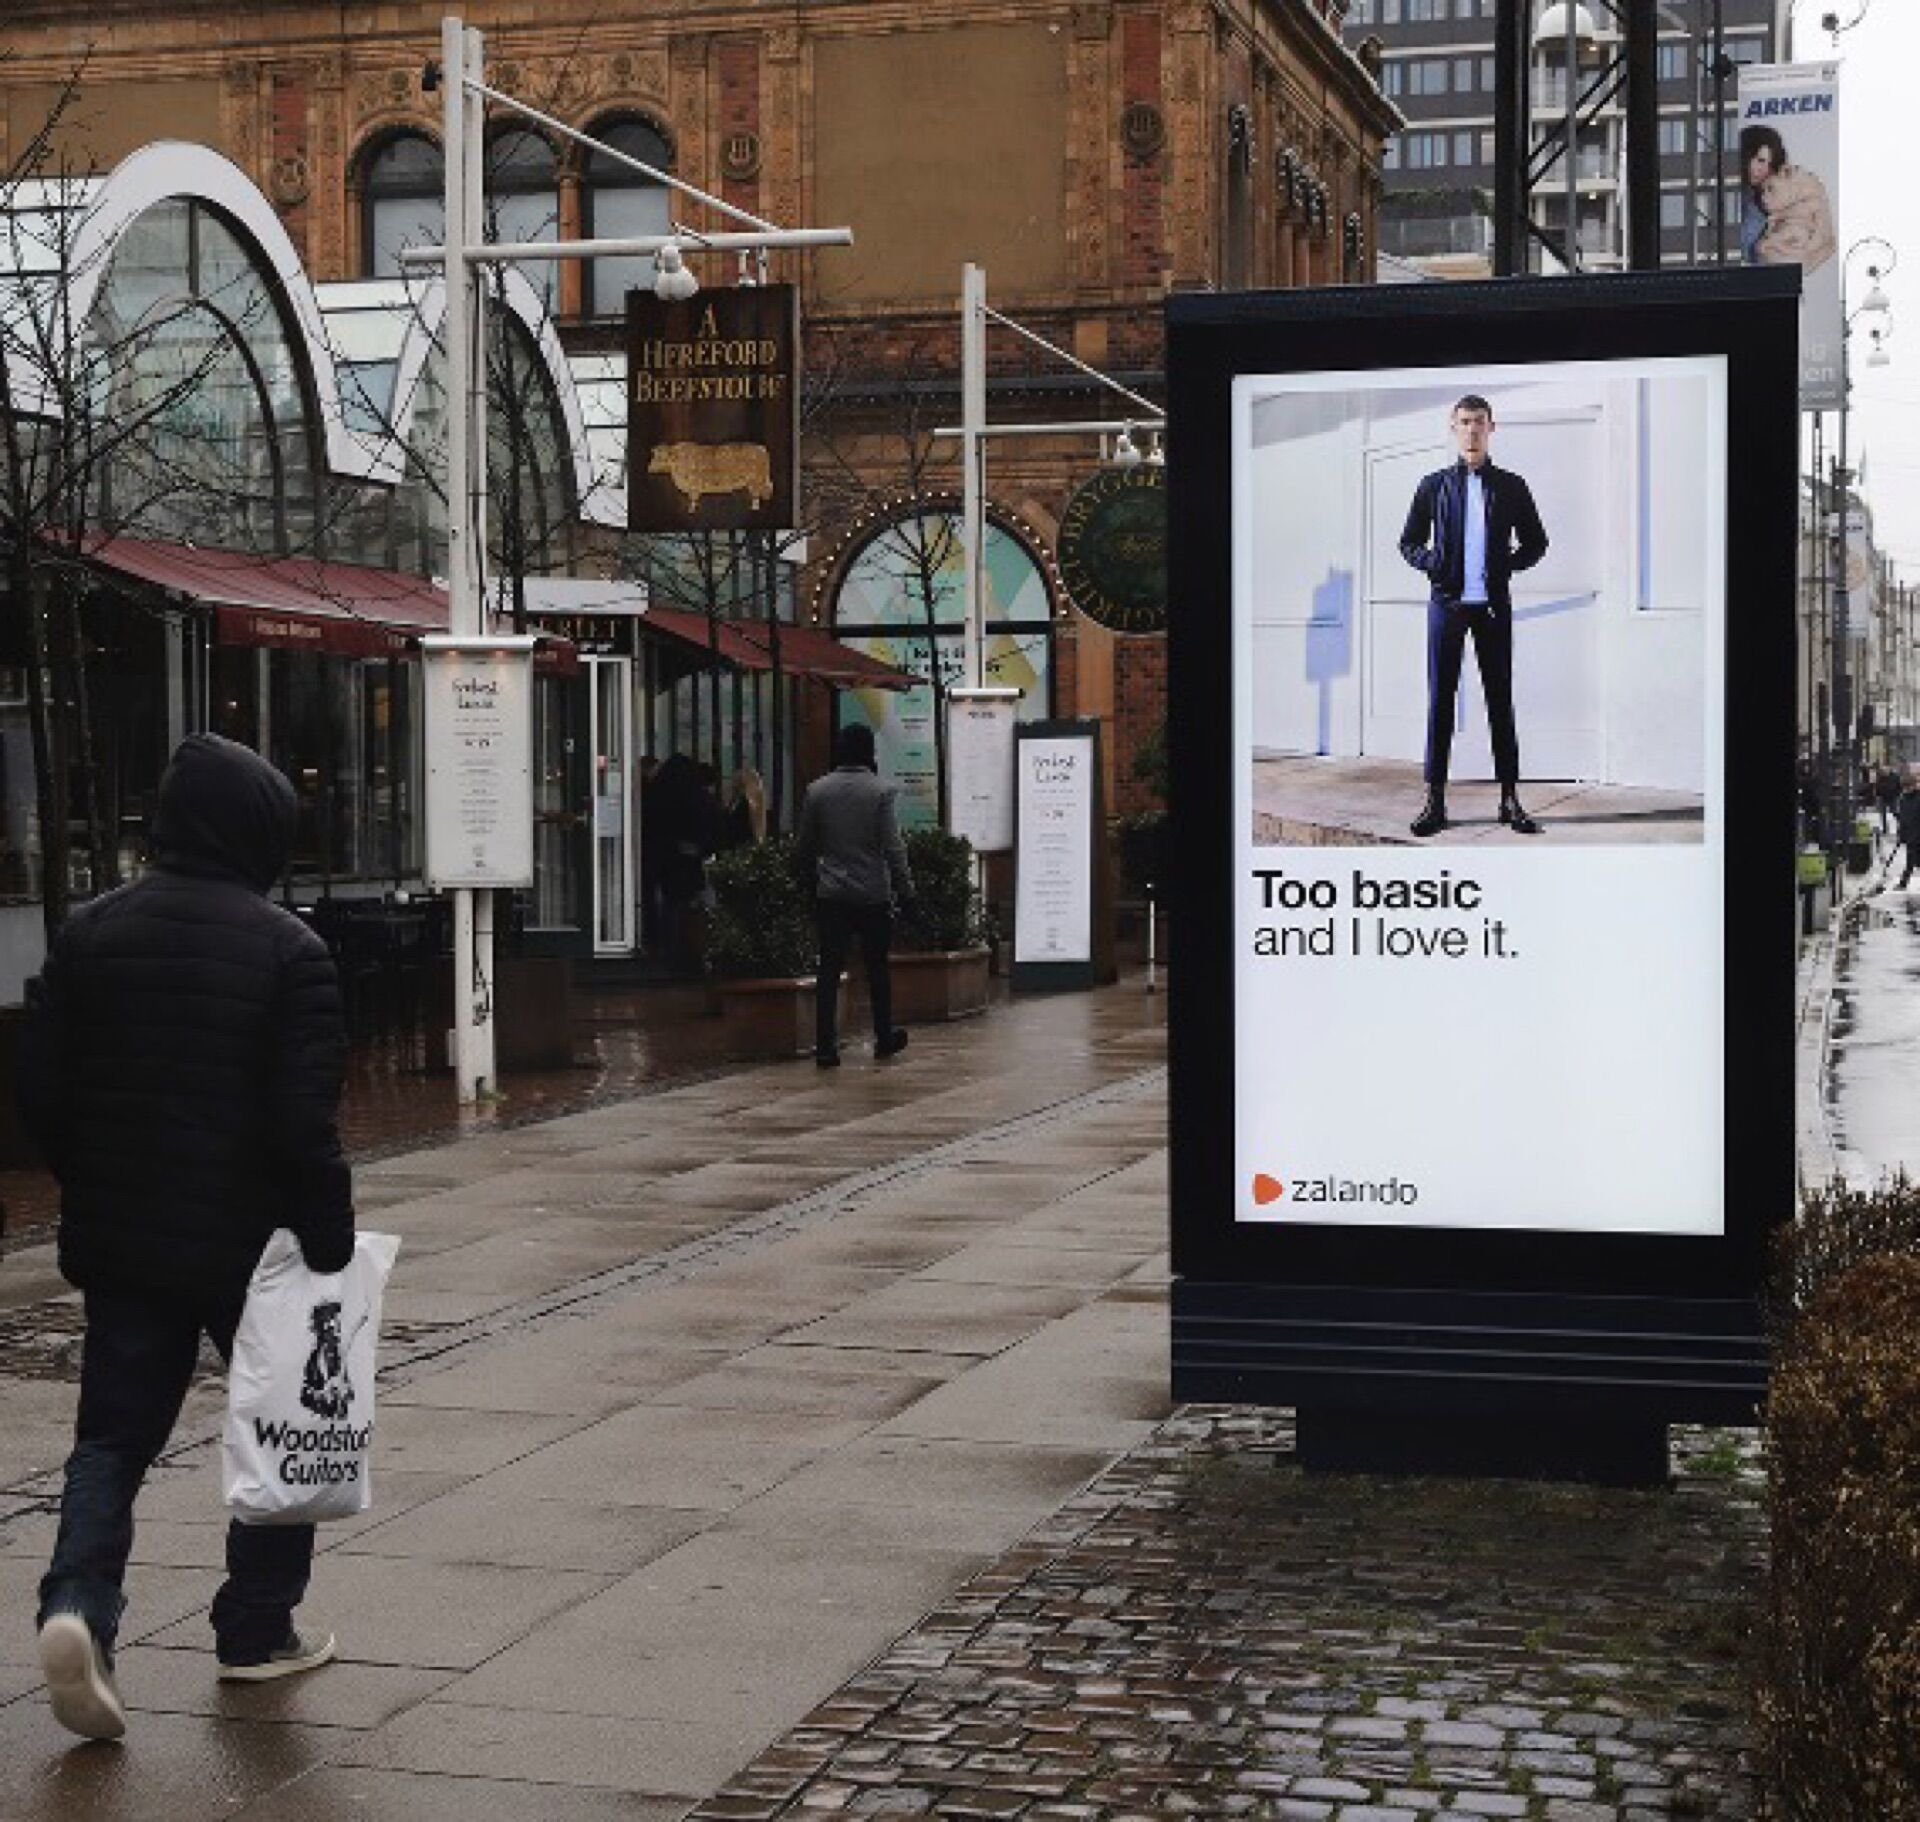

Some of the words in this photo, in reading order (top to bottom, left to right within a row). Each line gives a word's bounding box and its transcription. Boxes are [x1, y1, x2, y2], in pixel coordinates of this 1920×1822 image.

[1744, 94, 1833, 119] ARKEN
[698, 302, 721, 339] A
[642, 339, 778, 370] HEREFORD
[1252, 870, 1337, 910] Too
[1352, 870, 1482, 910] basic
[1254, 917, 1334, 956] and
[1352, 917, 1361, 956] I
[1376, 917, 1469, 957] love
[1484, 917, 1519, 958] it.
[1291, 1174, 1418, 1206] zalando
